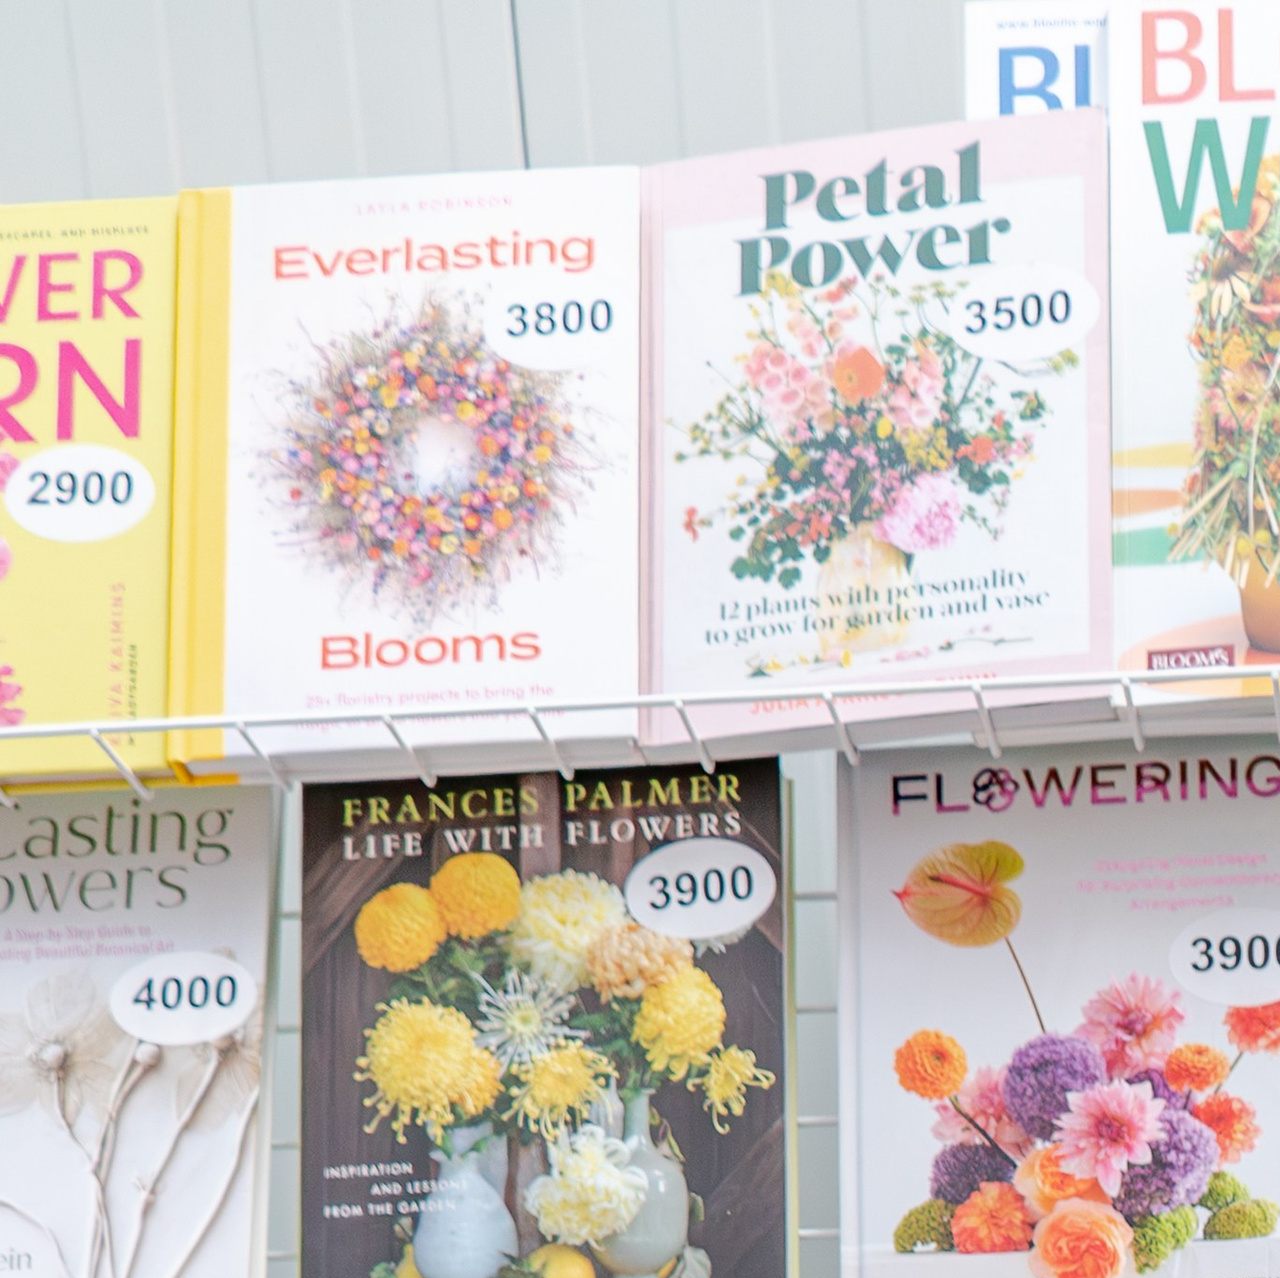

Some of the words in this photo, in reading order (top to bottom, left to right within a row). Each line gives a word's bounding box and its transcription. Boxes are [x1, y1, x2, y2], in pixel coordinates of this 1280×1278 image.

[761, 141, 983, 230] Petal
[273, 231, 596, 280] Everlasting
[733, 219, 1010, 295] Power
[506, 300, 614, 336] 3800
[965, 290, 1071, 334] 3500
[27, 471, 134, 505] 2900
[320, 630, 541, 668] Blooms
[342, 784, 539, 827] FRANCES
[566, 774, 743, 810] PALMER
[343, 834, 423, 860] LIFE
[445, 824, 545, 851] WITH
[566, 812, 743, 845] FLOWERS
[648, 866, 753, 910] 3900
[133, 975, 237, 1010] 4000
